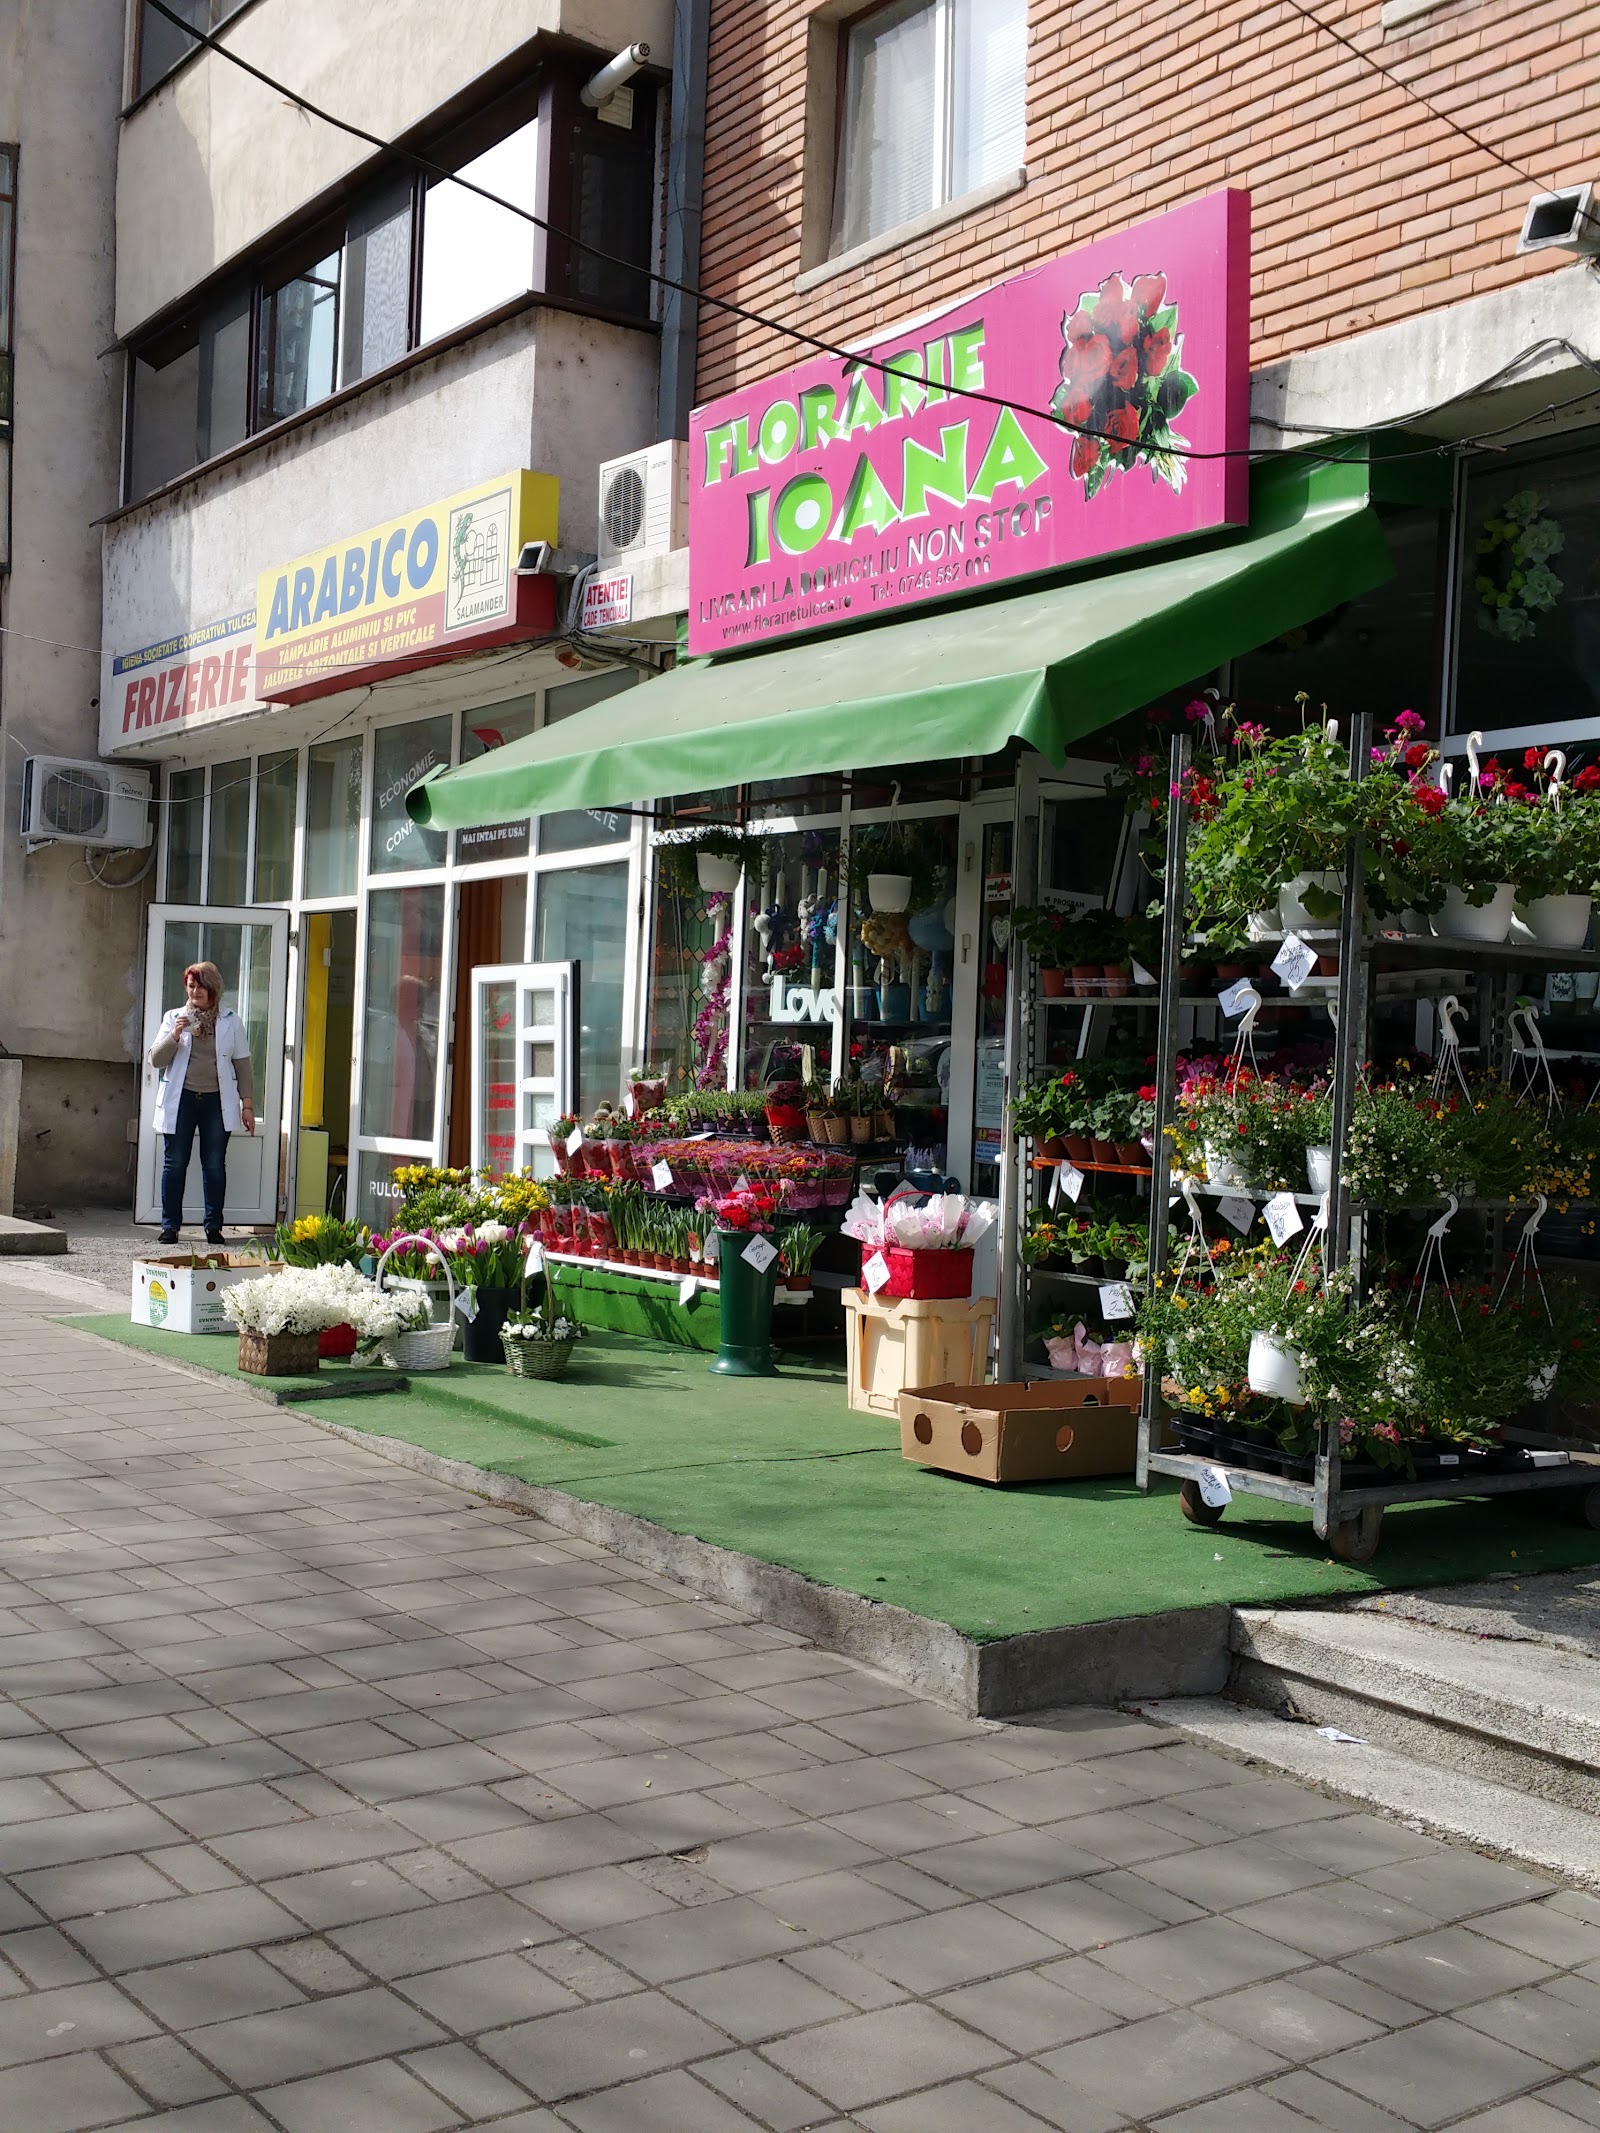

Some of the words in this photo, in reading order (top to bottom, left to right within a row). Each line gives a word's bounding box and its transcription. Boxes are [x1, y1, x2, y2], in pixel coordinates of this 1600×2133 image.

[743, 405, 1050, 569] IOANA
[265, 518, 439, 640] ARABICO
[699, 583, 767, 623] LIVRARI
[772, 577, 794, 603] LA
[800, 547, 900, 597] DOMICILIU
[906, 521, 965, 568] NON
[974, 495, 1053, 549] STOP
[898, 570, 931, 595] 0746
[935, 562, 960, 585] 582
[330, 618, 381, 650] ALUMINIU
[382, 617, 394, 633] SI
[396, 607, 417, 629] PVC
[456, 594, 504, 621] SALAMANDER
[583, 610, 598, 627] CADE
[143, 639, 178, 663] SOCIETATE
[178, 622, 227, 649] COOPERATIVA
[227, 611, 256, 635] TULCEA
[262, 664, 304, 690] JALUZELE
[305, 649, 366, 677] ORIZONTALE
[367, 642, 378, 658] SI
[379, 623, 435, 655] VERTICALE
[121, 643, 253, 734] FRIZERIE
[378, 749, 437, 811] ECONOMIE
[462, 832, 476, 845] MAI
[477, 829, 497, 842] INTAI
[498, 828, 507, 840] PE
[1053, 897, 1085, 908] PROGRAM
[145, 1268, 168, 1278] BANANAS
